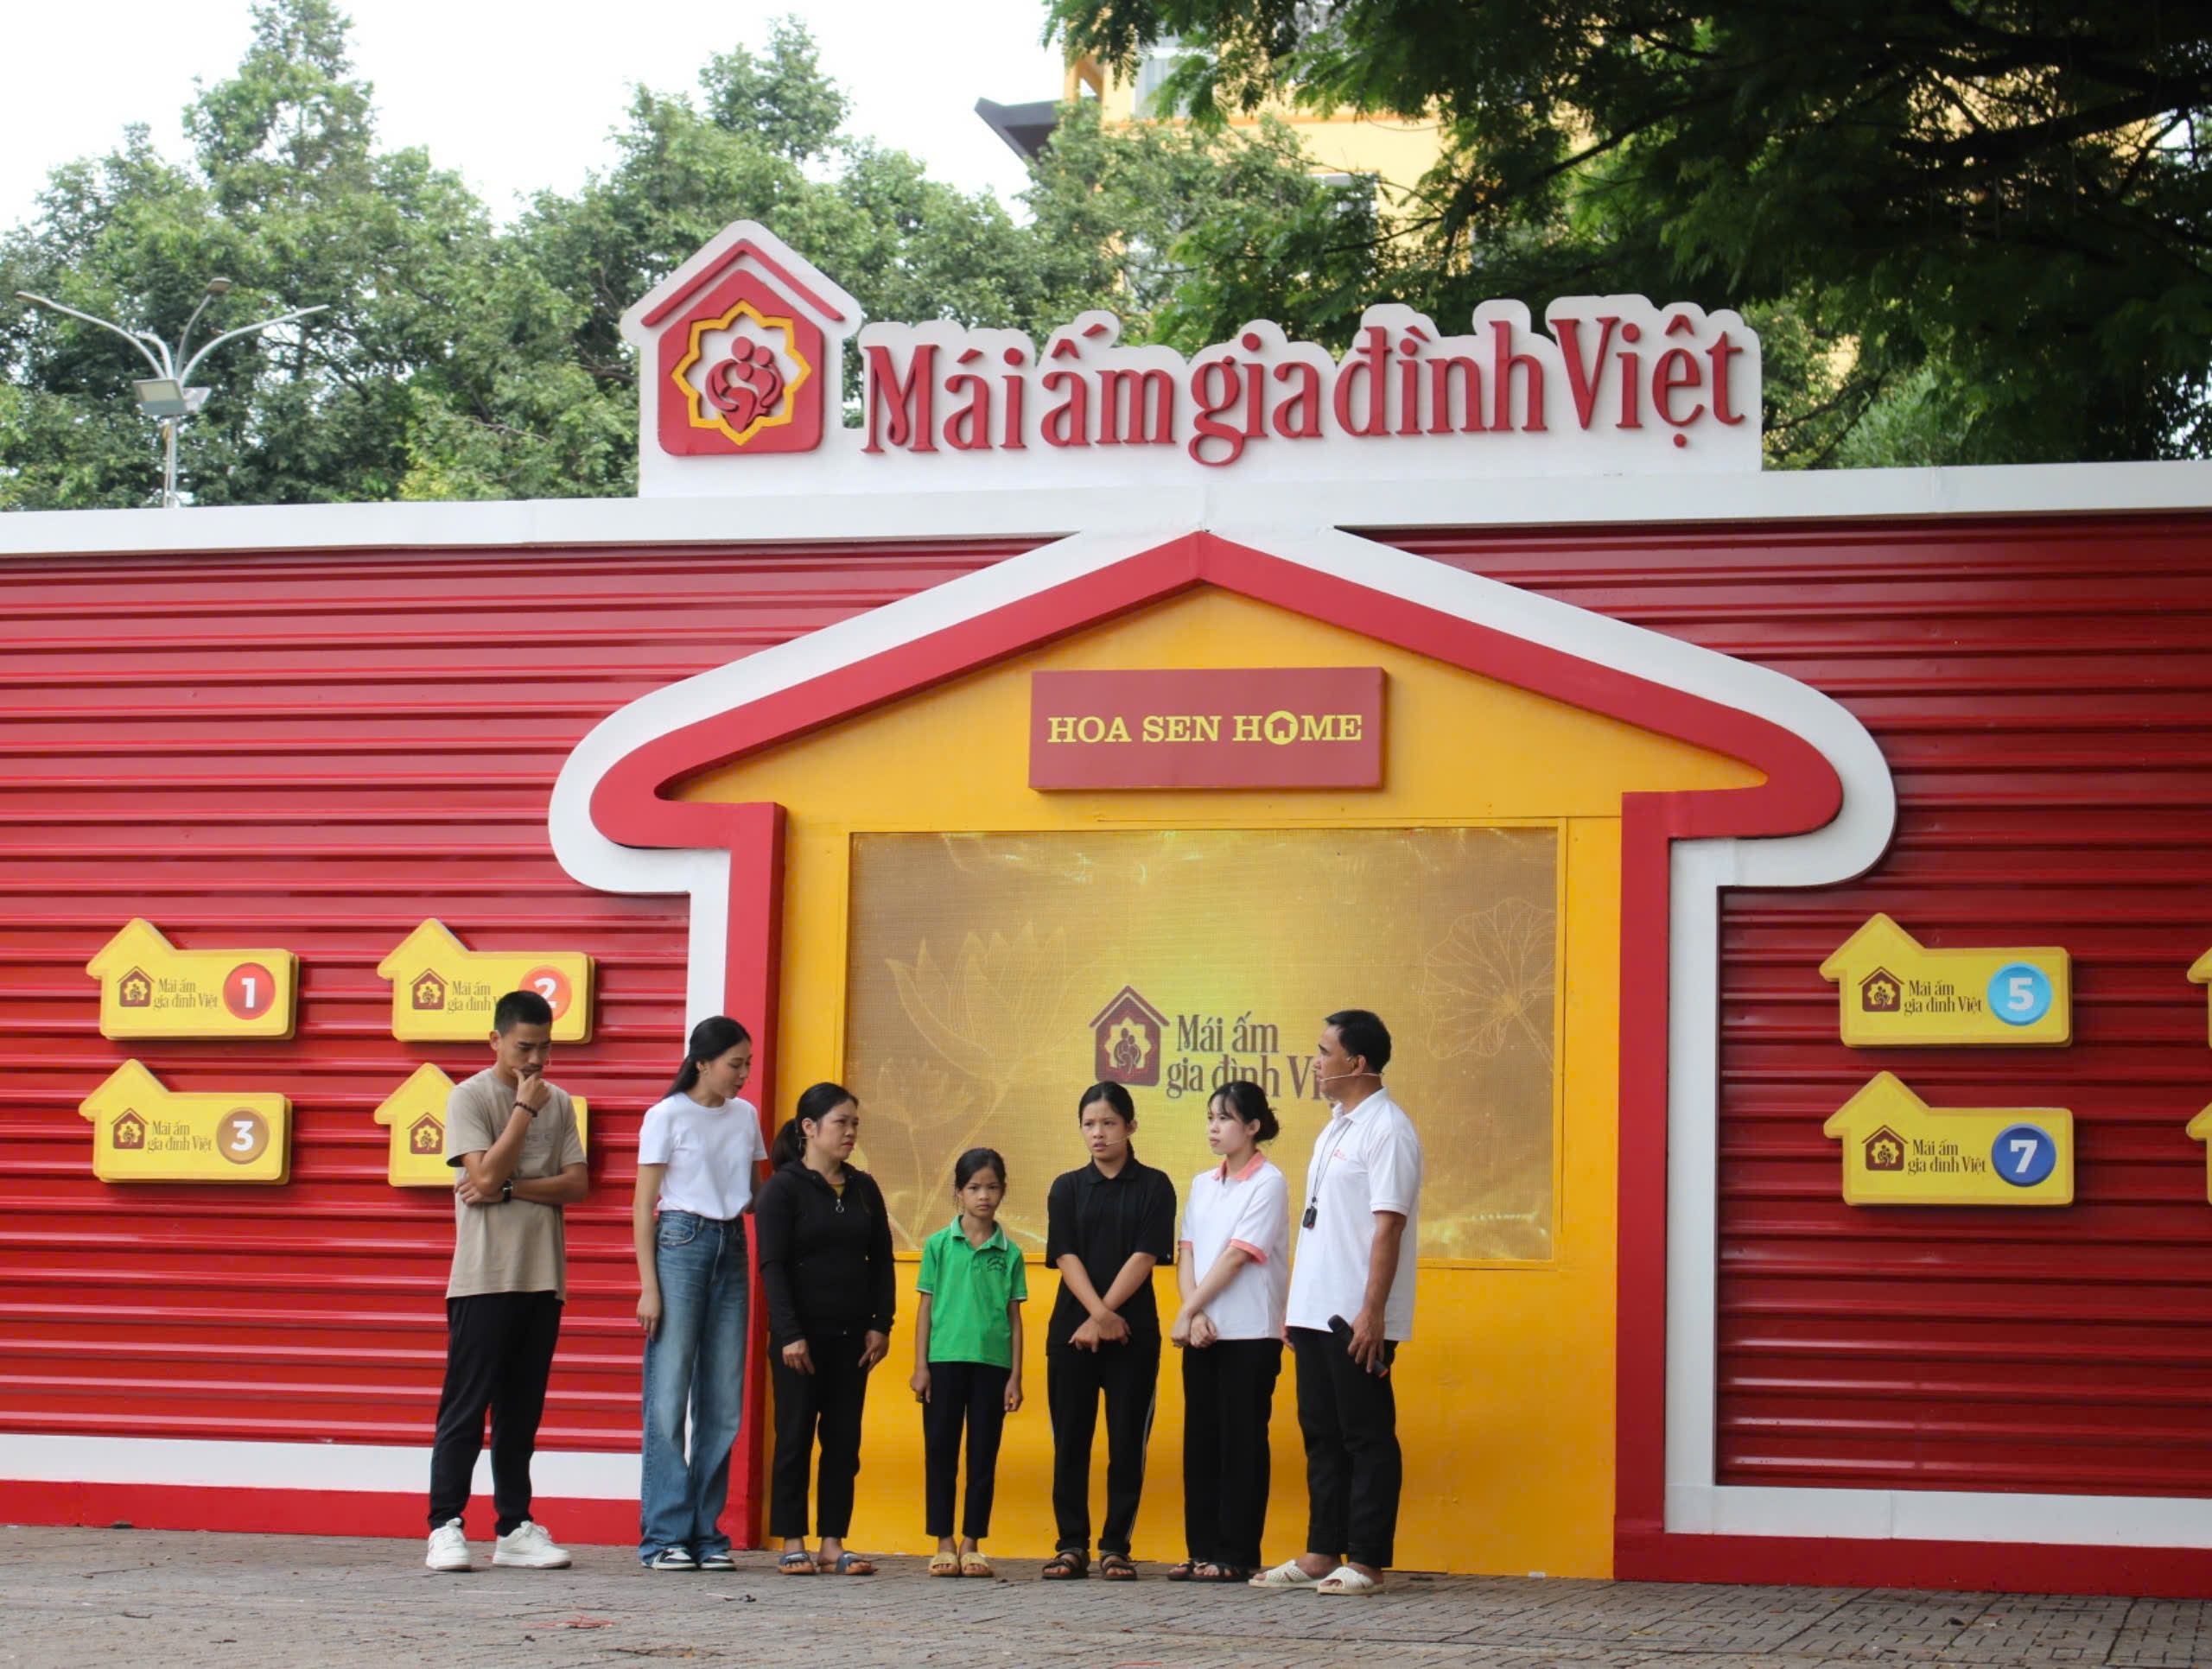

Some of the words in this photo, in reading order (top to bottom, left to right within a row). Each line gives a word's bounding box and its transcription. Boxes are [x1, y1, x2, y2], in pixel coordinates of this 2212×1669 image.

[861, 344, 1027, 454] Mái
[1040, 323, 1176, 447] ấm
[1188, 332, 1324, 466] gia
[1333, 320, 1548, 437] đình
[1549, 314, 1746, 448] Việt
[1047, 715, 1132, 743] HOA
[1142, 714, 1223, 742] SEN
[1232, 710, 1363, 746] HOME
[153, 994, 168, 1010] gia
[242, 978, 256, 1008] 1
[534, 977, 557, 1009] 2
[1908, 980, 1931, 996] Mái
[1935, 980, 1955, 996] ấm
[2007, 977, 2035, 1011] 5
[447, 997, 463, 1014] gia
[1904, 999, 1923, 1016] gia
[1957, 996, 1982, 1014] Việt
[1177, 1014, 1224, 1052] Mái
[1231, 1011, 1280, 1053] ấm
[1166, 1057, 1204, 1099] gia
[147, 1137, 162, 1153] gia
[231, 1120, 254, 1152] 3
[1912, 1139, 1936, 1155] Mái
[1938, 1139, 1959, 1155] ấm
[1907, 1158, 1926, 1176] gia
[1962, 1156, 1986, 1175] Việt
[2011, 1139, 2037, 1173] 7
